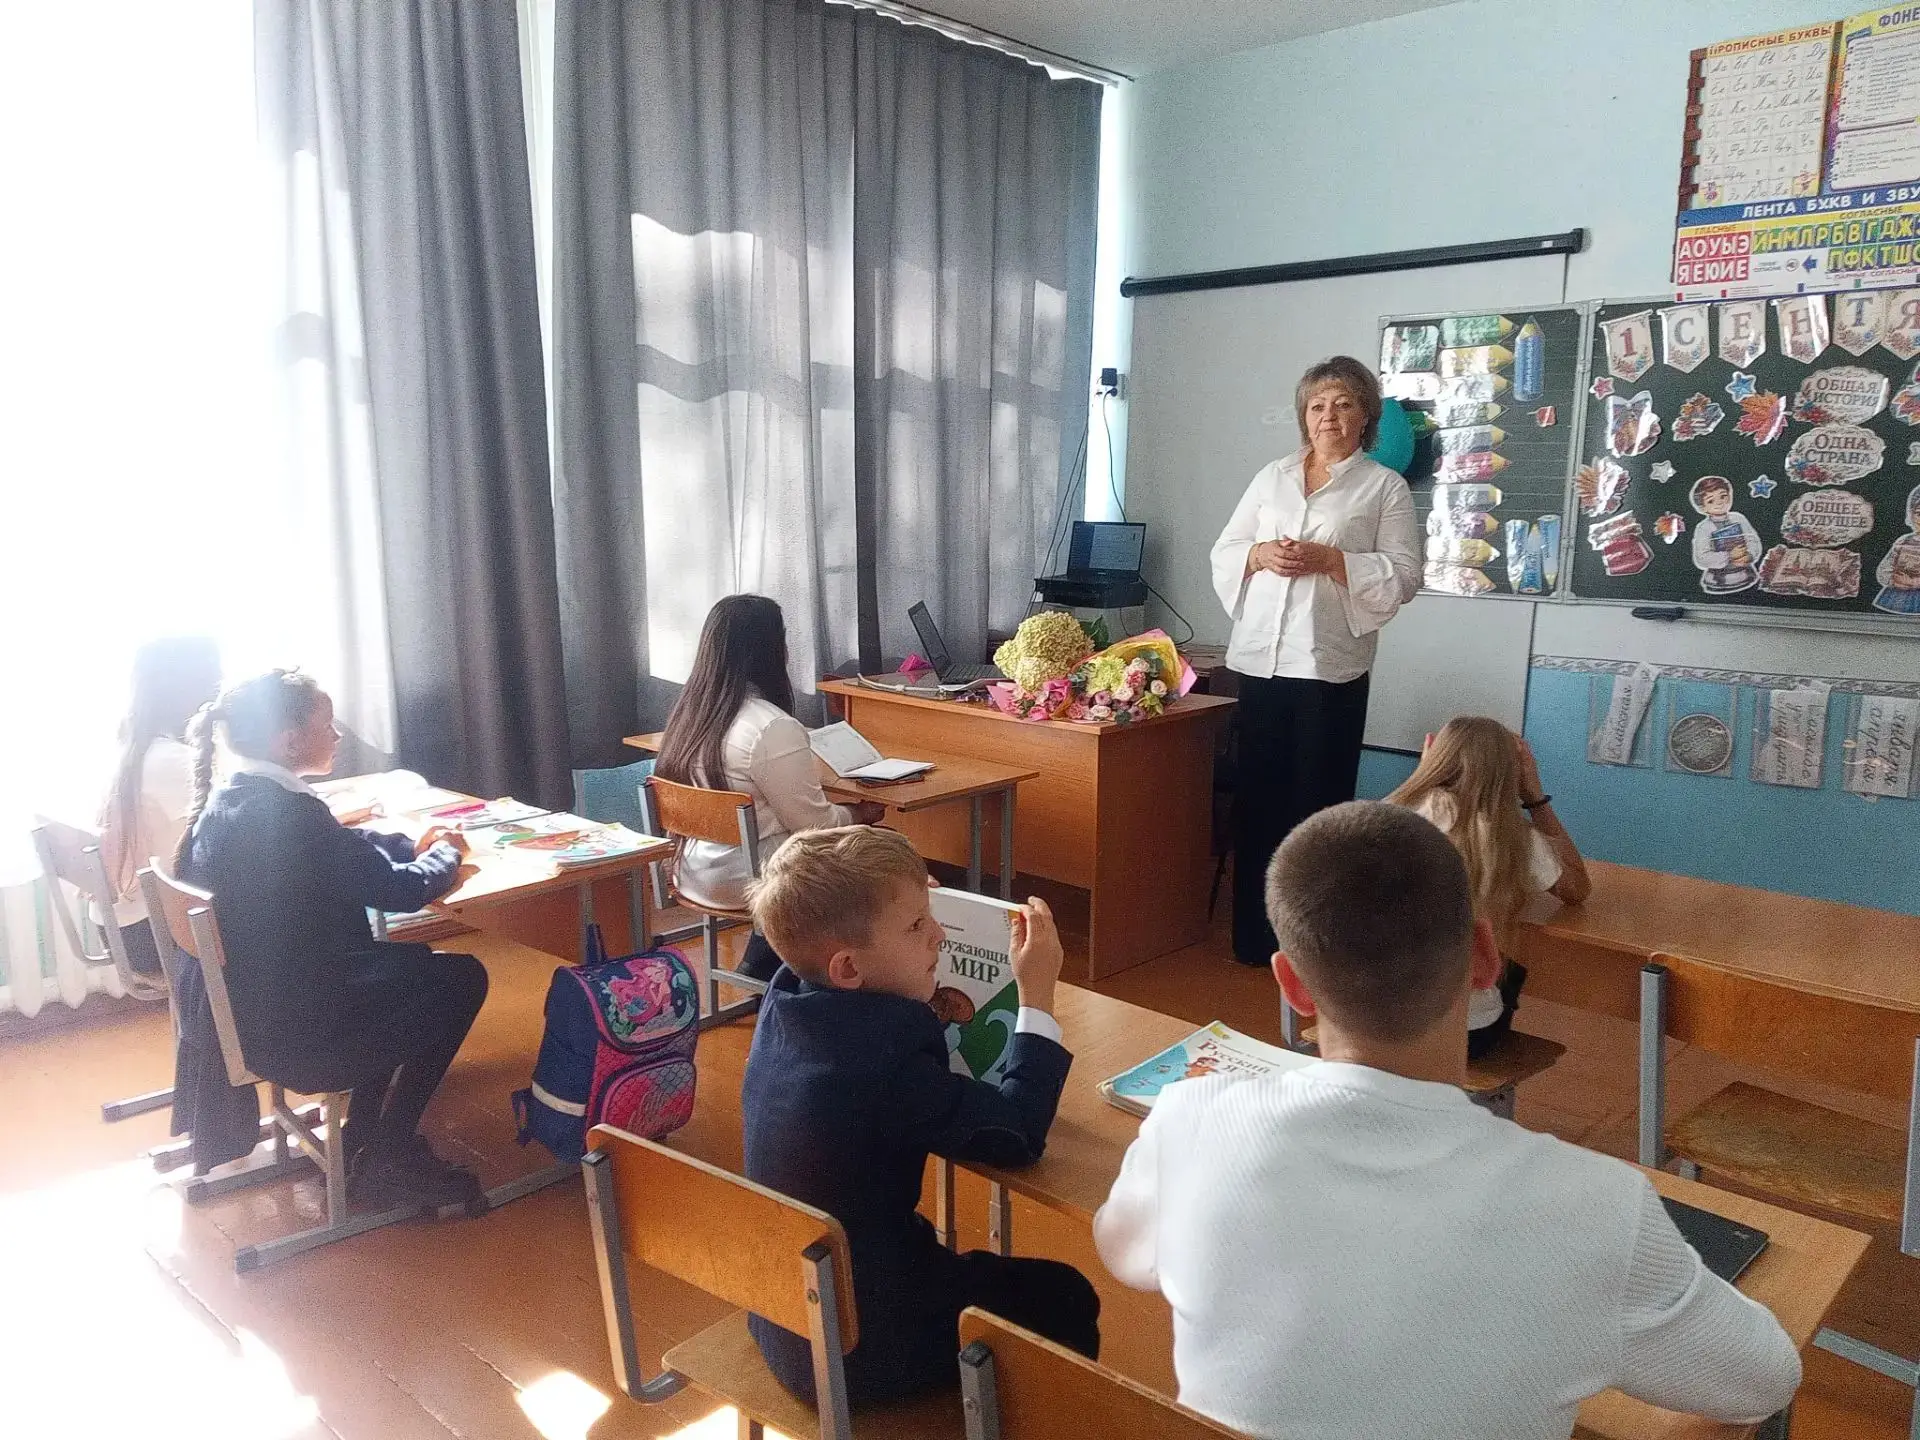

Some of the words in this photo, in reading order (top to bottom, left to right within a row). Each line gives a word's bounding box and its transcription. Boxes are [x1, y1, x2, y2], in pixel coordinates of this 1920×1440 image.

[1709, 34, 1784, 55] ПРОПИСНЫЕ
[1788, 25, 1833, 41] БУКВЫ
[1742, 202, 1796, 219] ЛЕНТА
[1862, 191, 1876, 205] И
[1840, 206, 1903, 220] СОГЛАСНЫЕ
[1620, 327, 1638, 358] 1
[1816, 377, 1877, 393] ОБЩАЯ
[1814, 433, 1870, 450] ОДНА
[1804, 449, 1872, 464] СТРАНА
[1802, 500, 1862, 515] ОБЩЕЕ
[1800, 513, 1869, 528] БУДУЩЕЕ
[950, 954, 1000, 985] МИР
